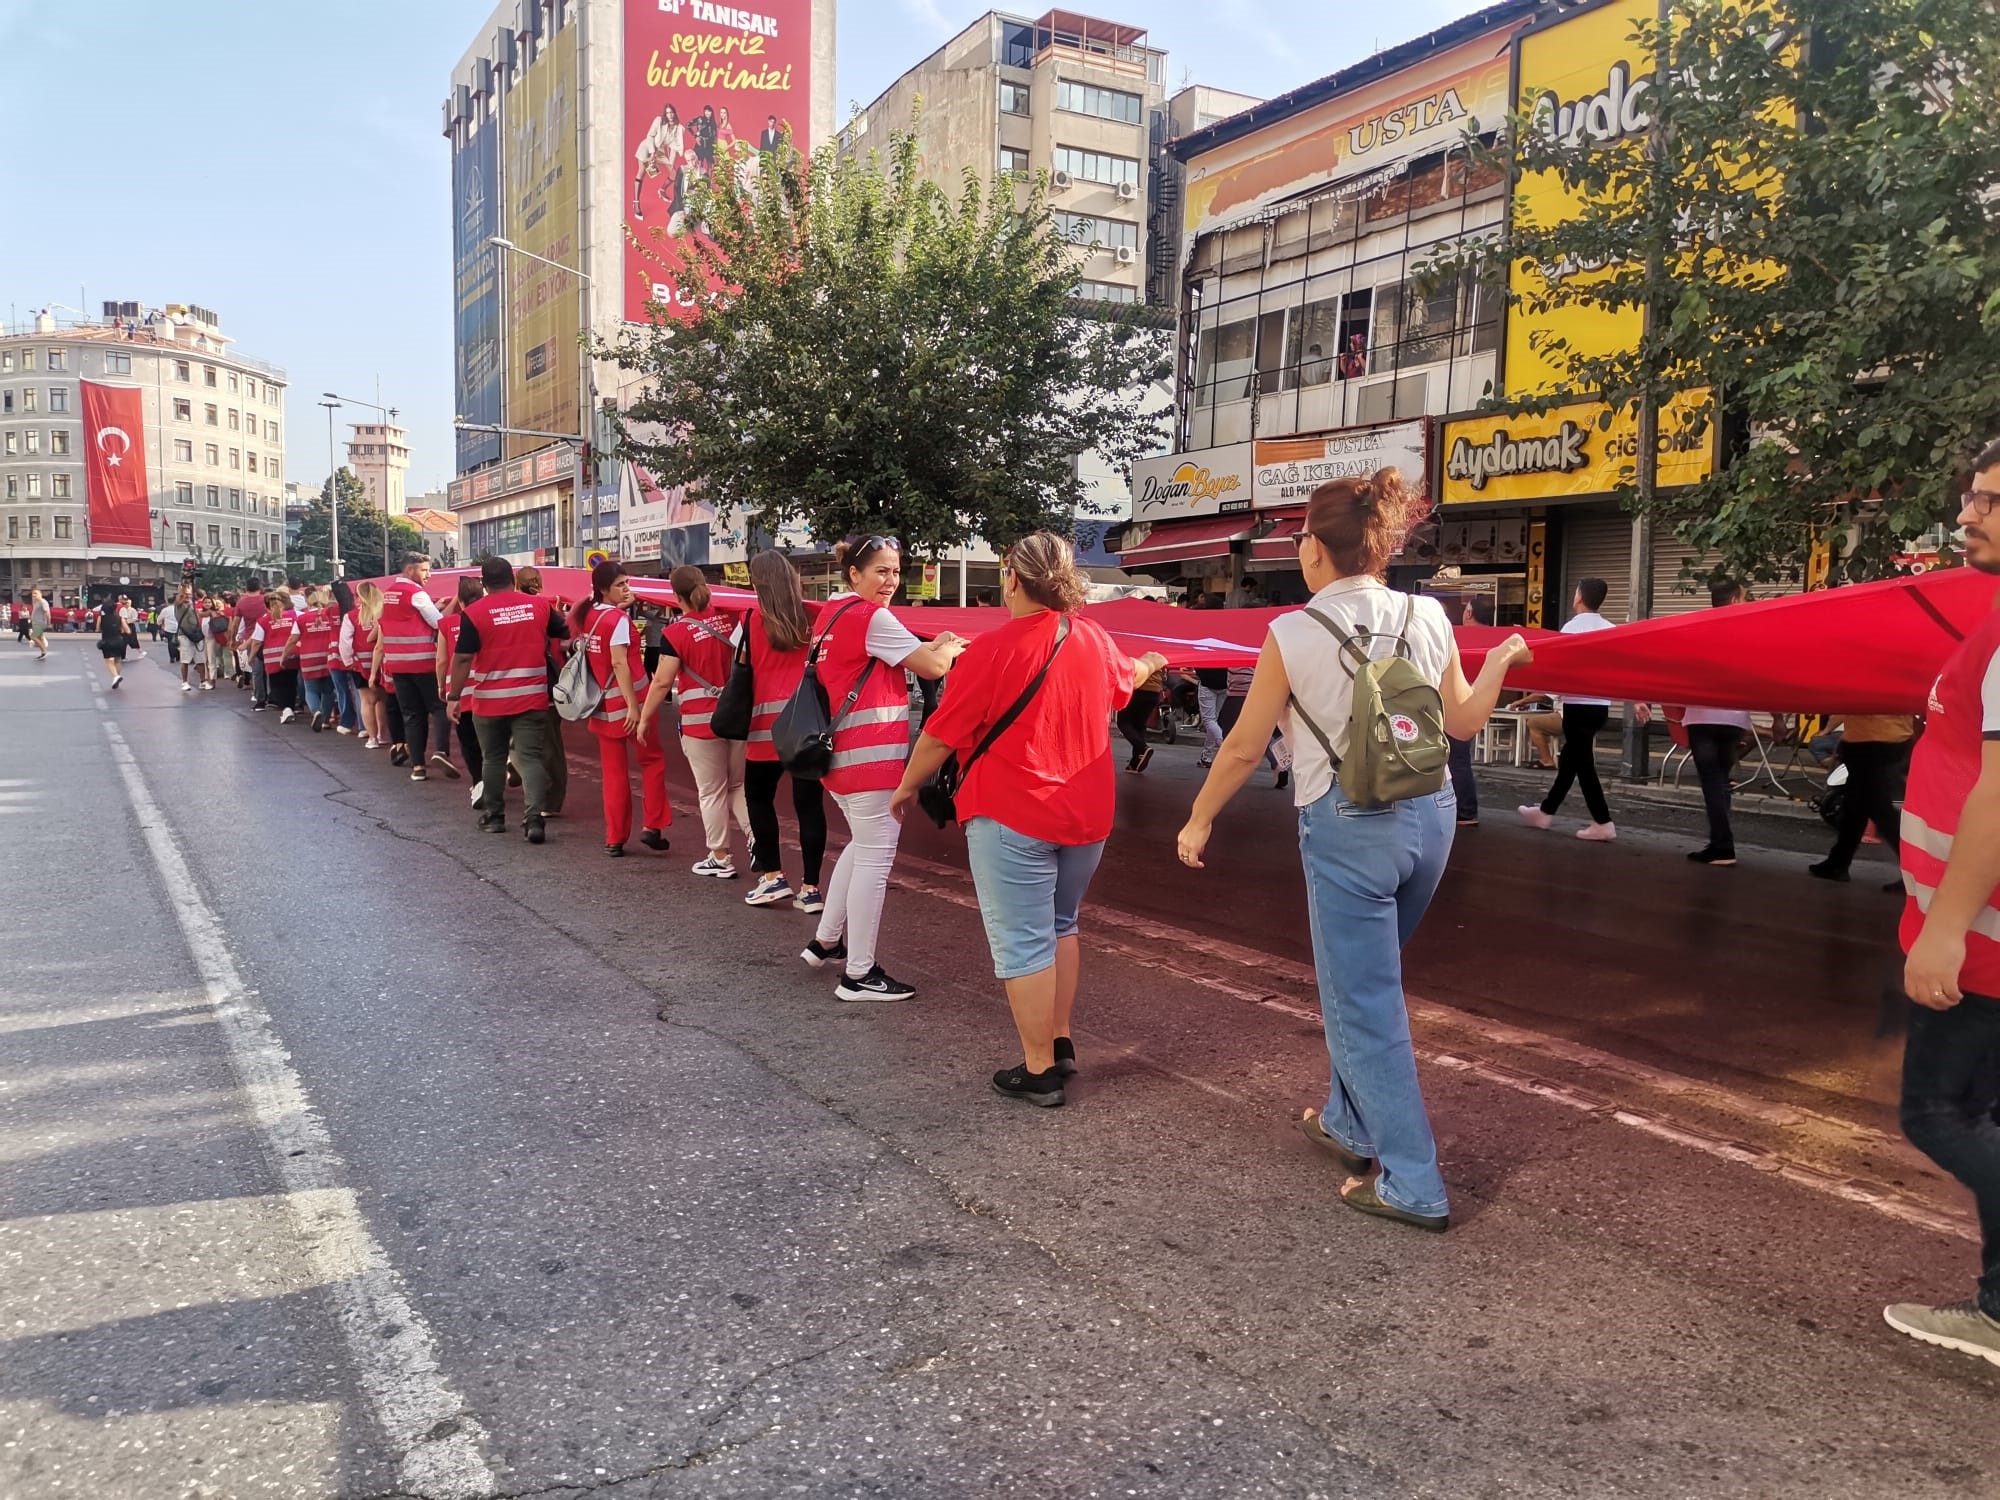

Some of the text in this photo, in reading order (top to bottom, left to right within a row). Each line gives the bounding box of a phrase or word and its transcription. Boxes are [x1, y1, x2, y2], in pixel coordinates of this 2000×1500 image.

[669, 30, 765, 55] severiz
[647, 50, 792, 90] birbirimizi
[1348, 88, 1467, 155] USTA
[1328, 434, 1385, 455] USTA
[1447, 420, 1590, 490] Aydamak
[1138, 475, 1192, 513] Doğan
[1281, 487, 1294, 498] ALO
